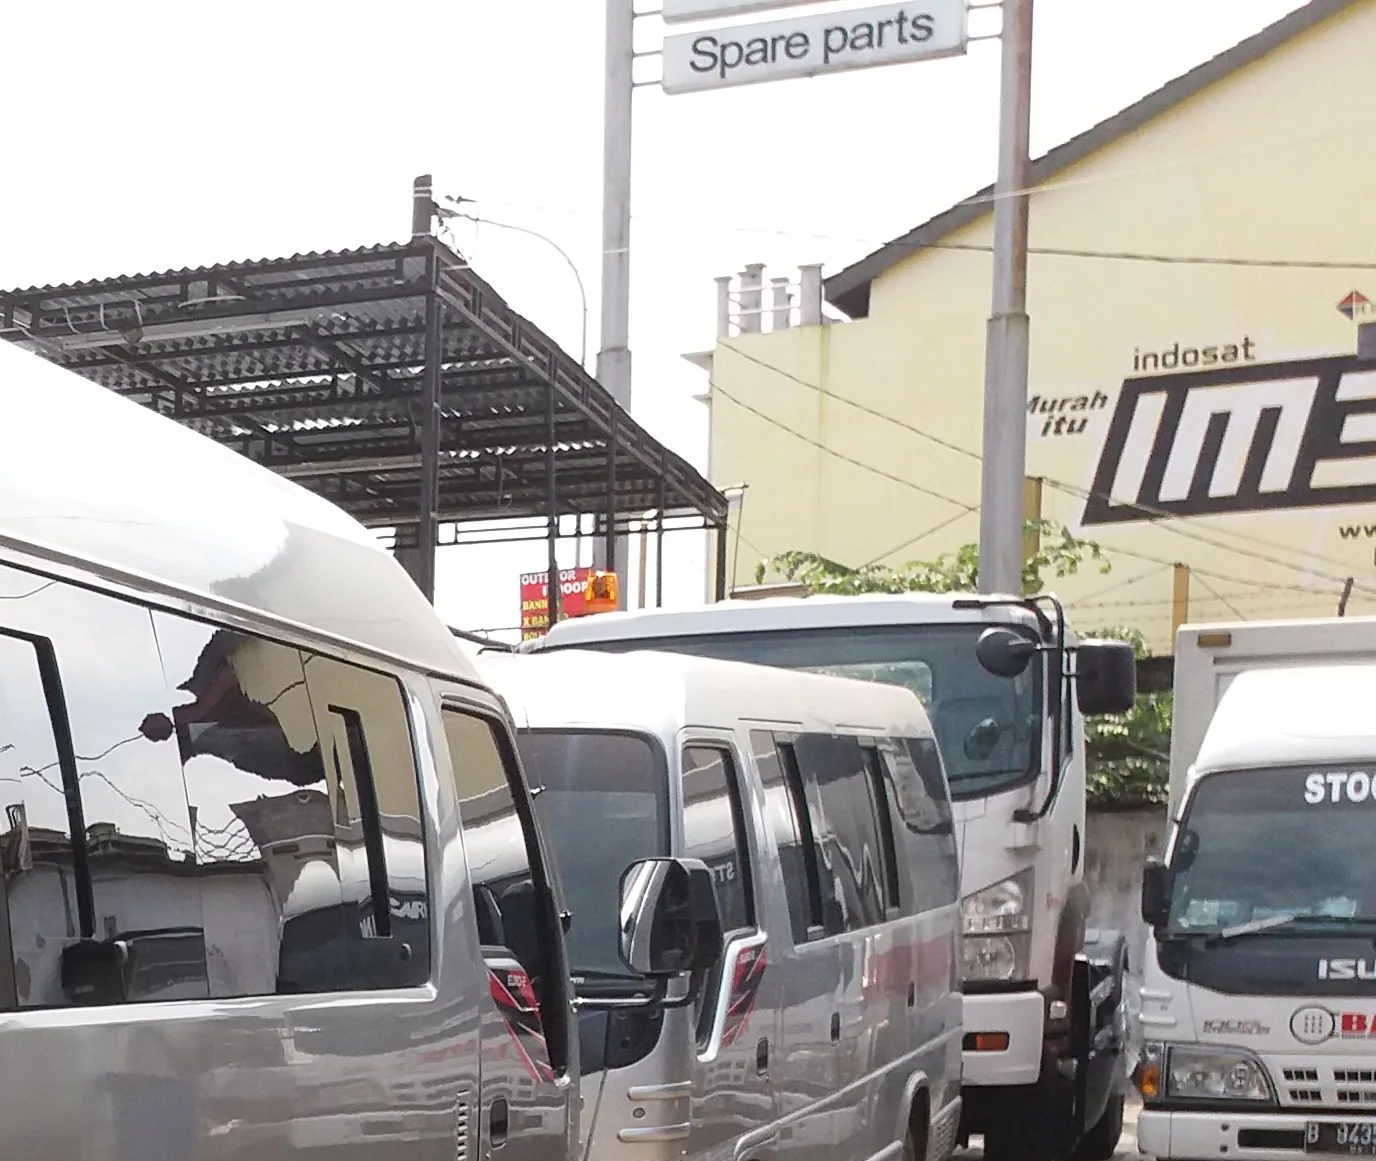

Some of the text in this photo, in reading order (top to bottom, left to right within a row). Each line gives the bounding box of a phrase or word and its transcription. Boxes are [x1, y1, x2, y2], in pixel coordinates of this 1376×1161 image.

[689, 10, 935, 79] Spare parts
[1133, 335, 1256, 371] indosat
[1041, 415, 1088, 437] itu
